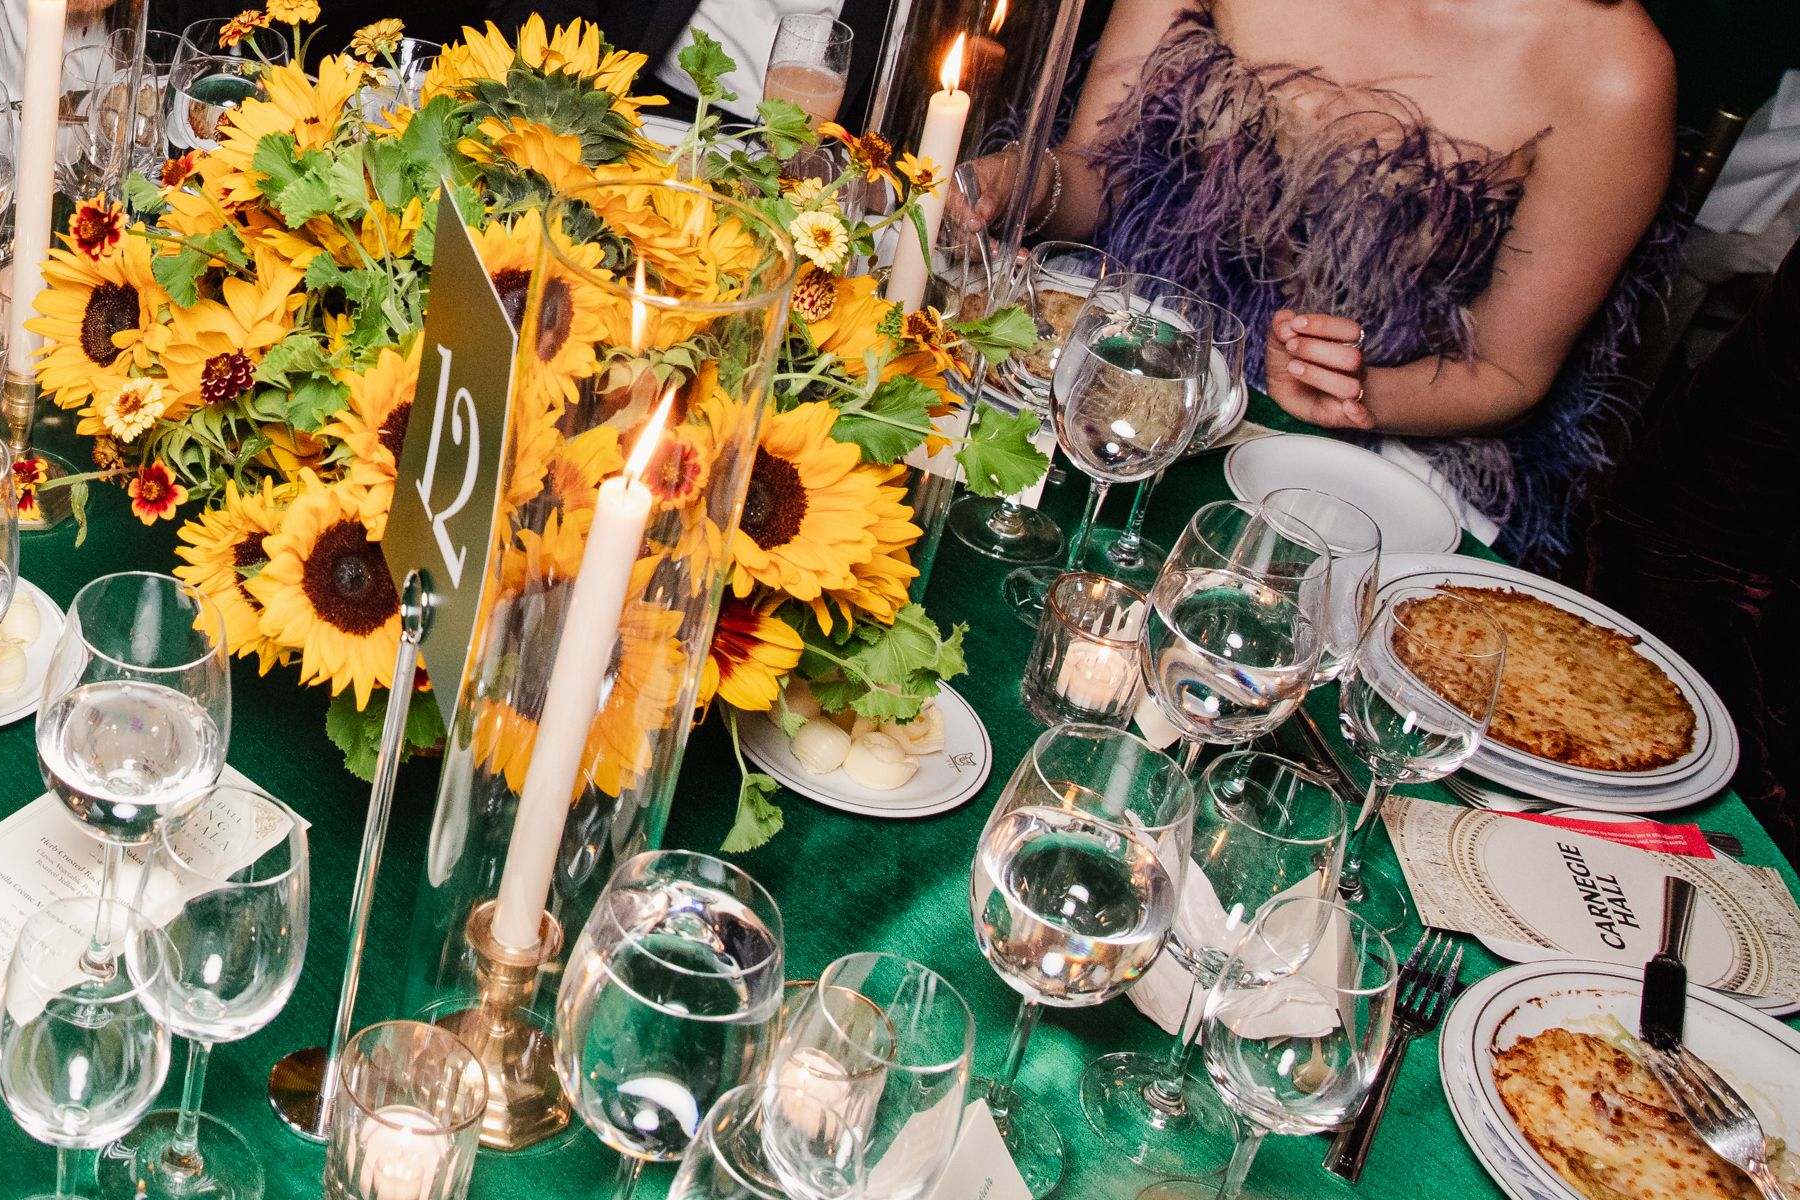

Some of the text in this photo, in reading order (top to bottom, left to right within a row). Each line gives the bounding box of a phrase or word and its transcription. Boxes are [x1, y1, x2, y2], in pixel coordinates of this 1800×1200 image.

[415, 342, 481, 590] 12
[1556, 841, 1627, 951] CARNEGIE
[1595, 874, 1641, 930] HALL
